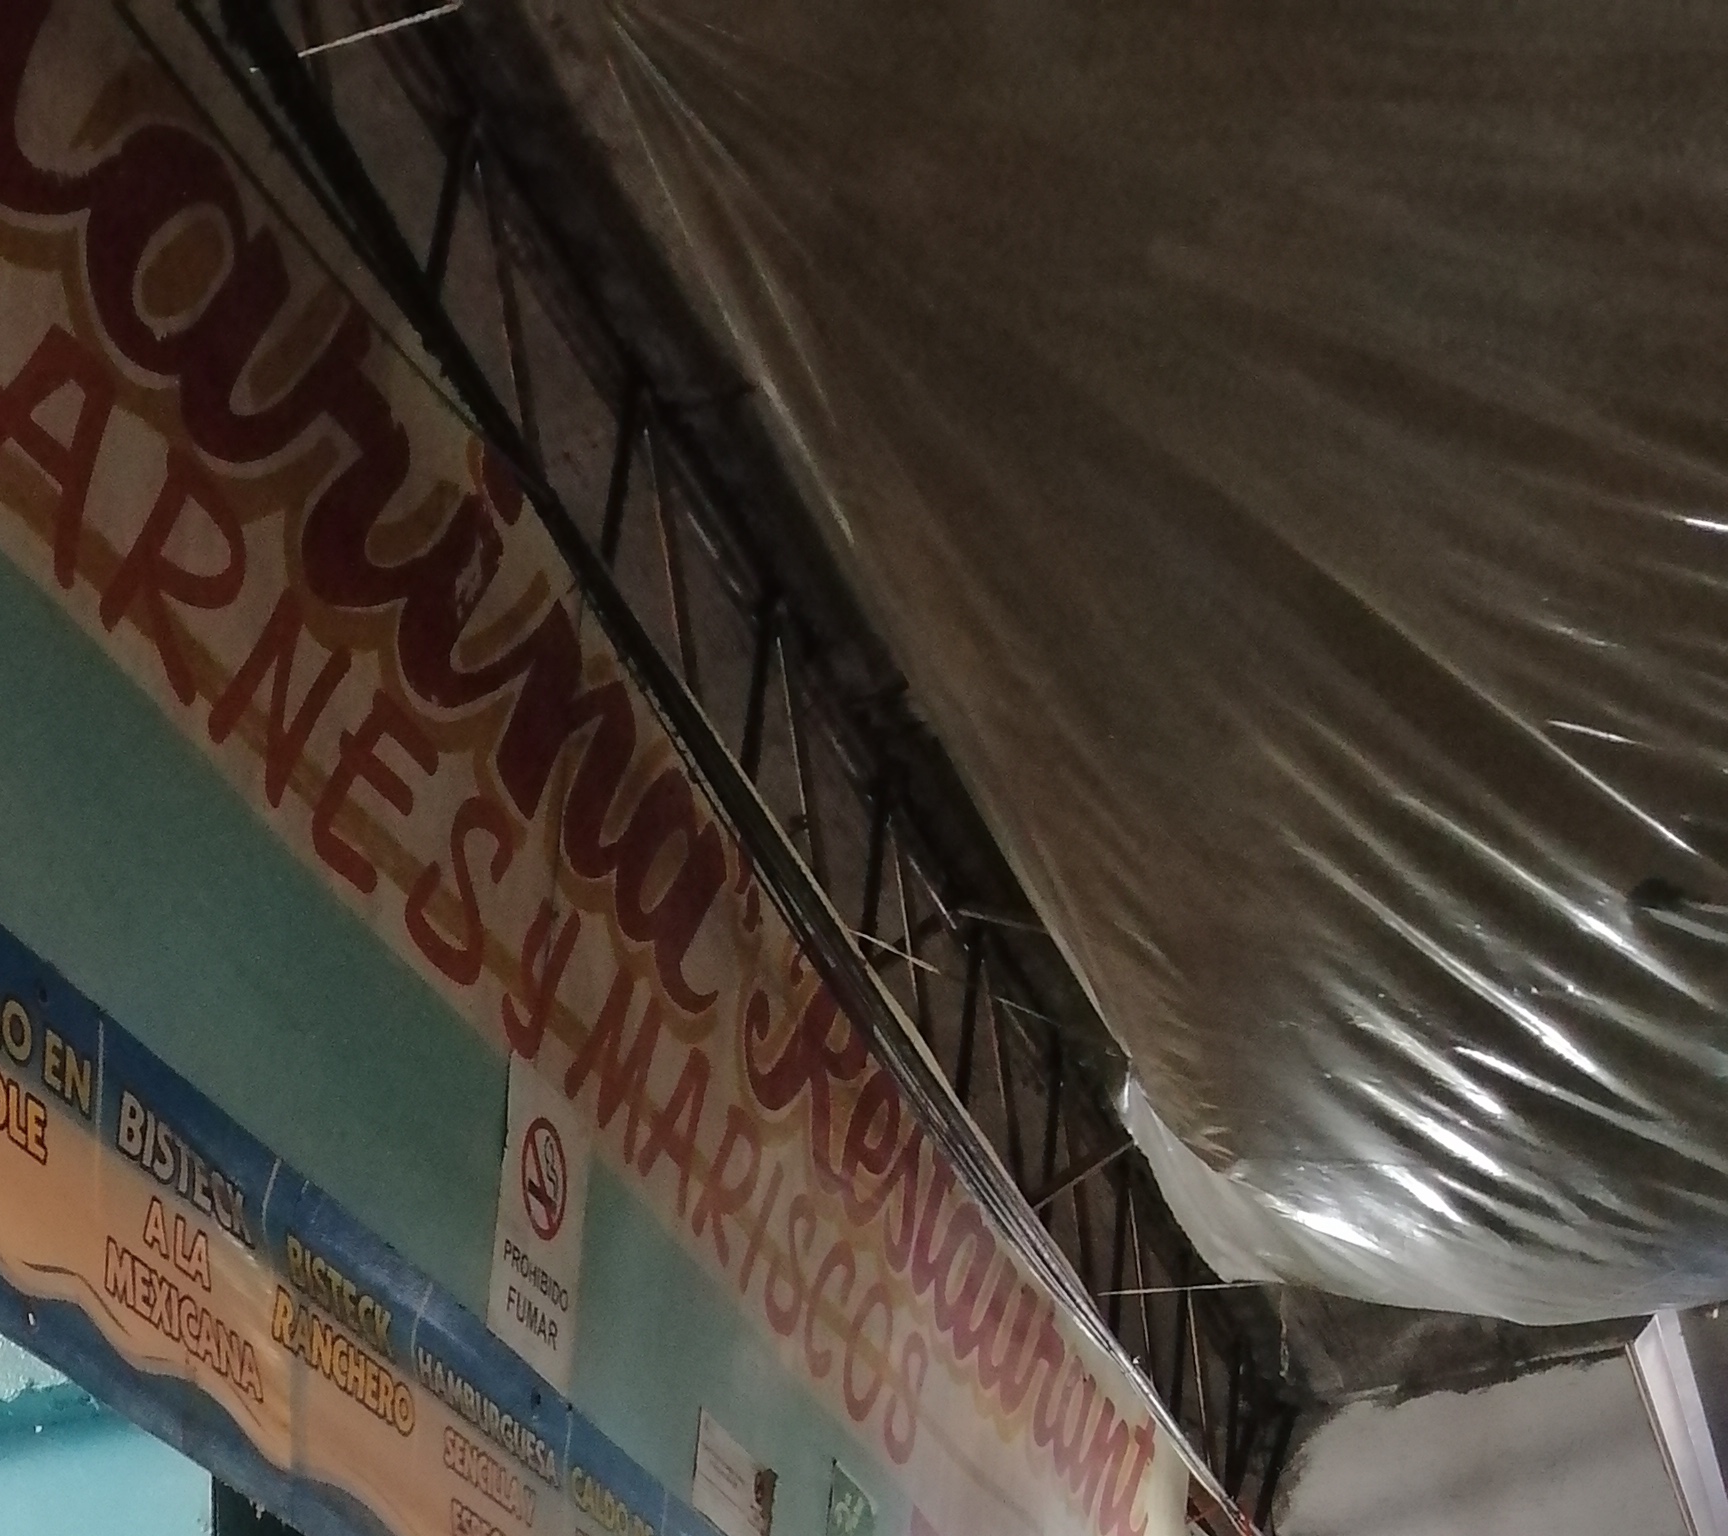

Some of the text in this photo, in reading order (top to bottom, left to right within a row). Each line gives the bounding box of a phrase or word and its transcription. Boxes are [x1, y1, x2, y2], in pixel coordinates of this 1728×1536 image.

[42, 1033, 94, 1114] EN
[117, 1090, 256, 1250] BISTECK
[563, 960, 929, 1466] MARISCOS
[143, 1197, 211, 1292] A LA
[503, 1237, 569, 1312] PROHIBIDO
[104, 1237, 264, 1404] MEXICANA
[272, 1284, 416, 1437] RANCHERO
[506, 1284, 558, 1351] FUMAR
[418, 1346, 561, 1489] HAMBURGUESA
